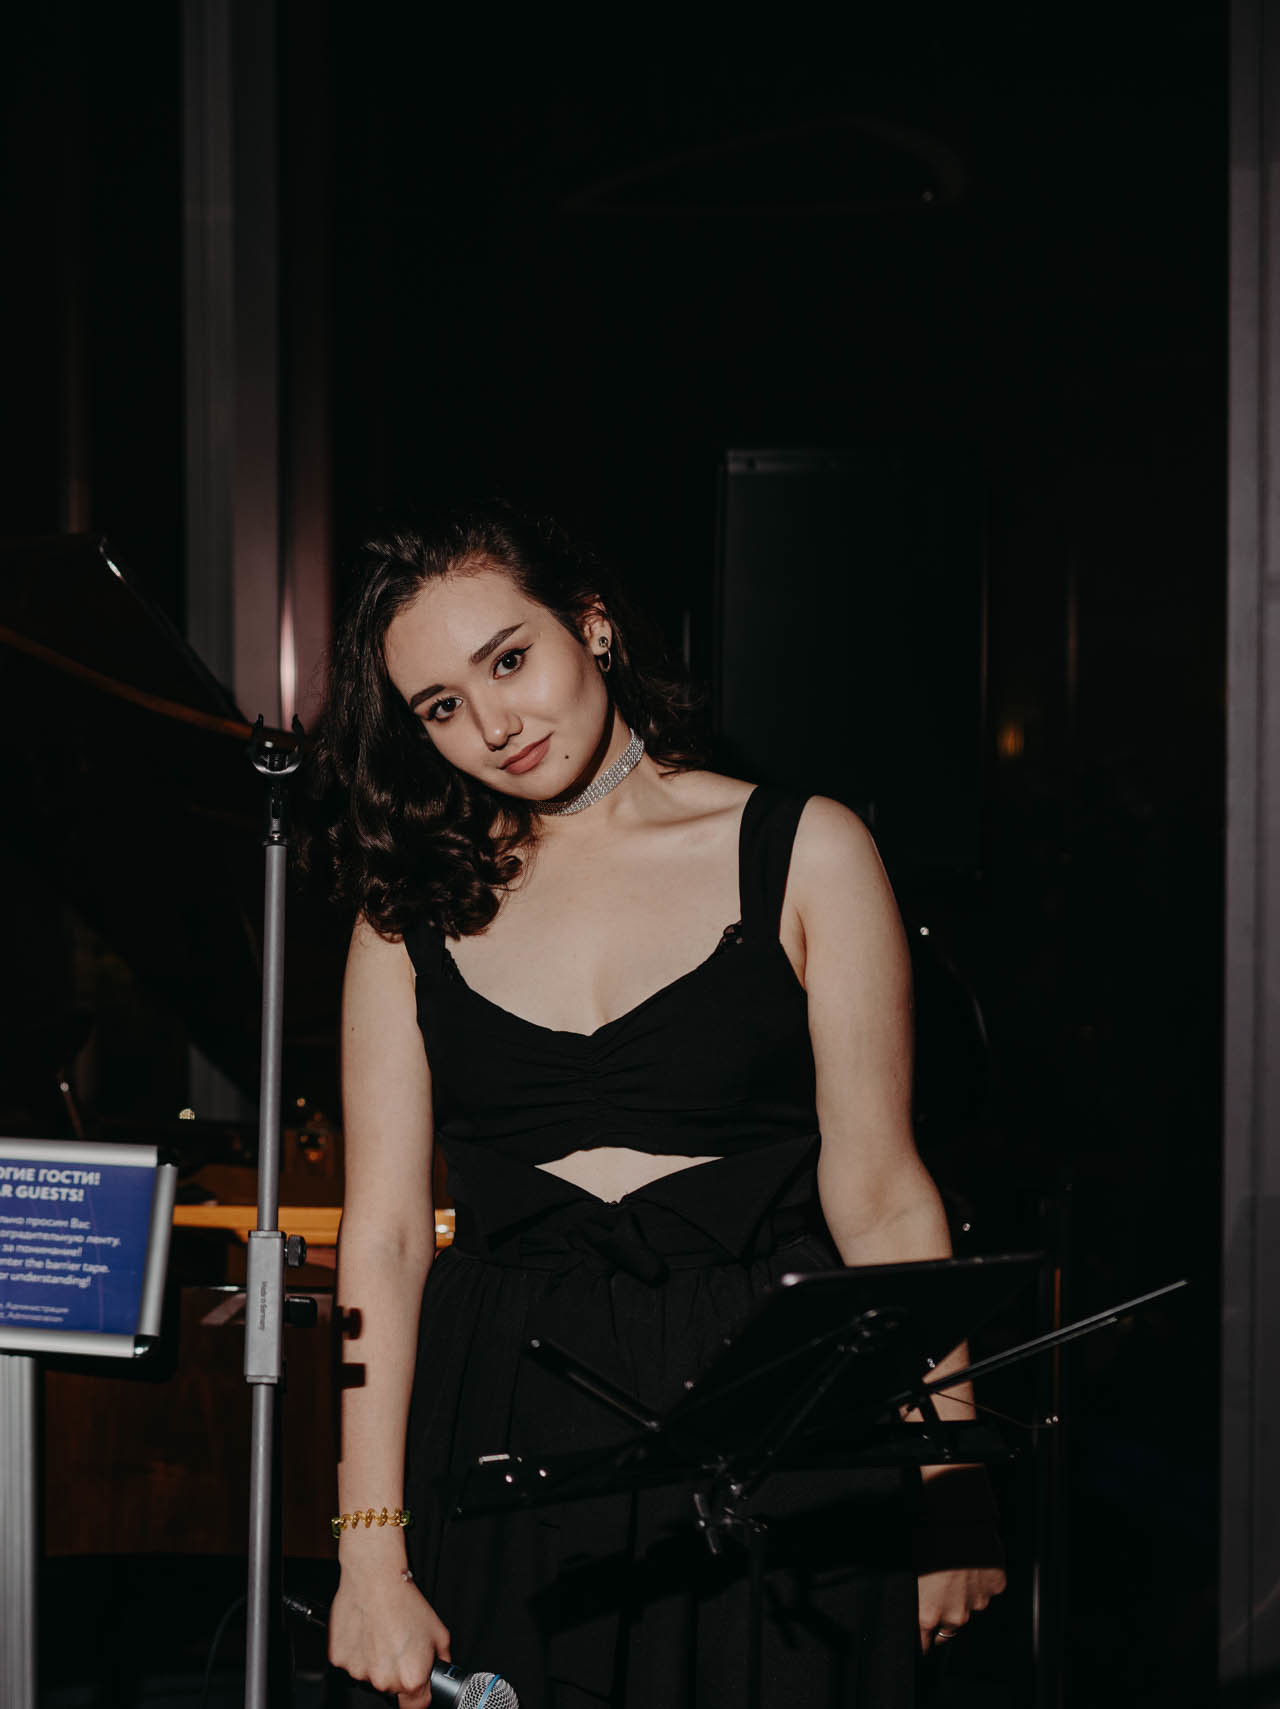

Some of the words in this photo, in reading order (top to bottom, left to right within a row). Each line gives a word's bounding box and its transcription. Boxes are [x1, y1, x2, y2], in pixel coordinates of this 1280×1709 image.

[38, 1168, 100, 1186] ГОСТИ!
[15, 1185, 84, 1202] GUESTS!
[70, 1217, 91, 1229] Вас
[1, 1244, 15, 1253] за
[24, 1258, 44, 1269] the
[45, 1259, 82, 1271] barrier
[10, 1272, 91, 1289] understanding!
